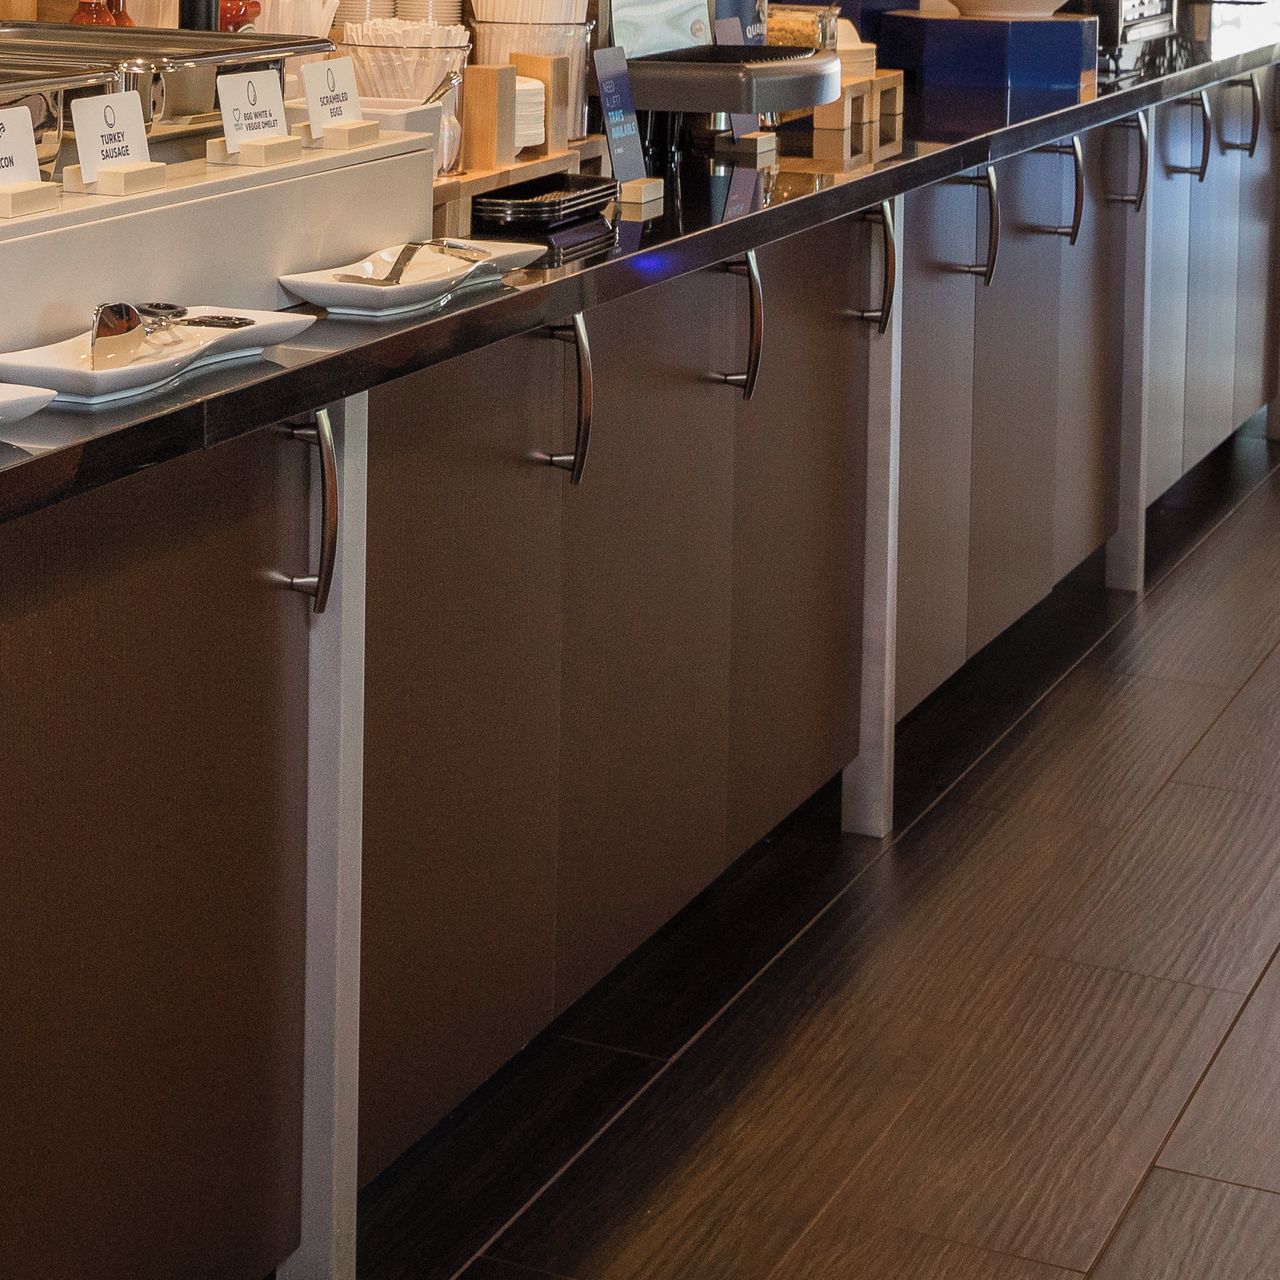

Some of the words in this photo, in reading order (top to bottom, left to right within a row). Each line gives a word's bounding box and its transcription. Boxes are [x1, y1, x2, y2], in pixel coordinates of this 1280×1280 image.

[319, 91, 349, 107] SCRAMBLED
[243, 111, 253, 121] EGG
[253, 109, 269, 120] WHITE
[329, 106, 343, 119] EGGS
[244, 121, 262, 131] VEGGIE
[100, 130, 126, 146] TURKEY
[100, 145, 130, 161] SAUSAGE
